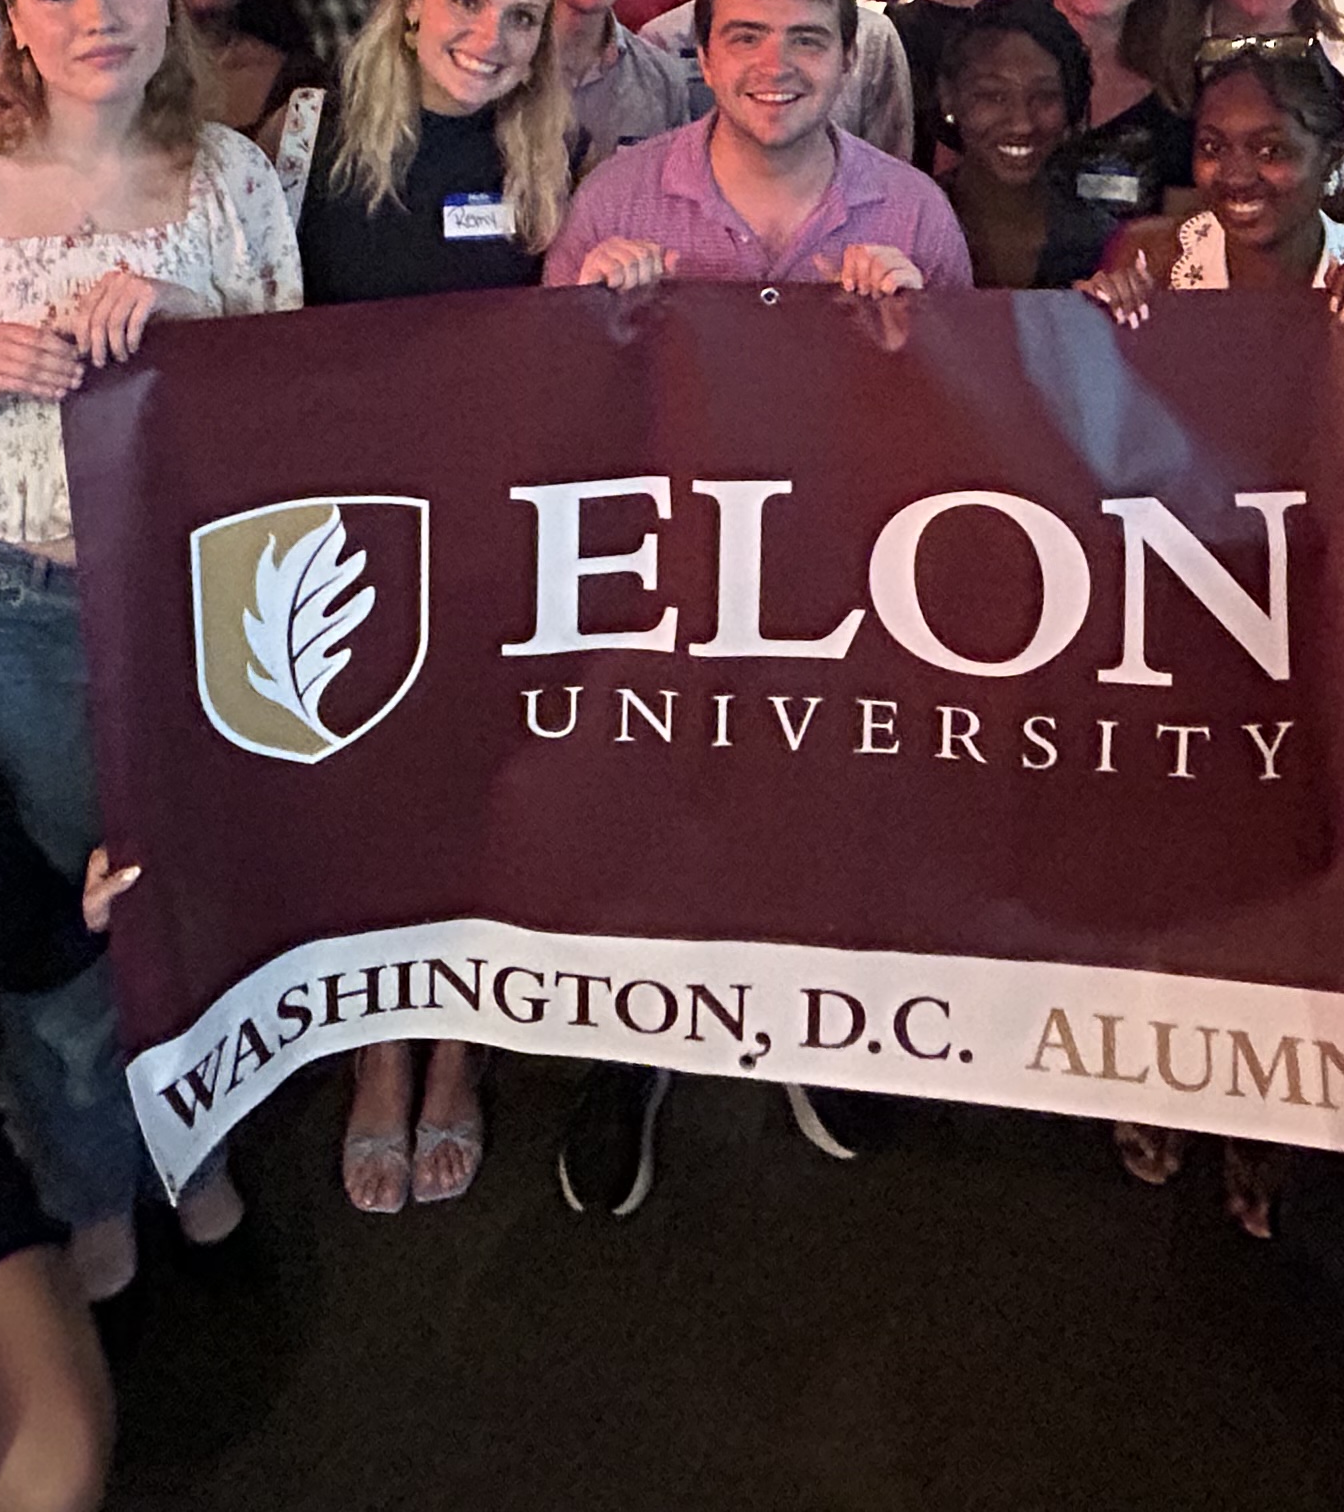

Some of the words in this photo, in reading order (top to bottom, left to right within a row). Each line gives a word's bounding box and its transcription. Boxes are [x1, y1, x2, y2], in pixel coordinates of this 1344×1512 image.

[500, 472, 1309, 687] ELON
[522, 684, 1303, 782] UNIVERSITY
[158, 956, 774, 1133] WASHINGTON,
[799, 990, 973, 1066] D.C.
